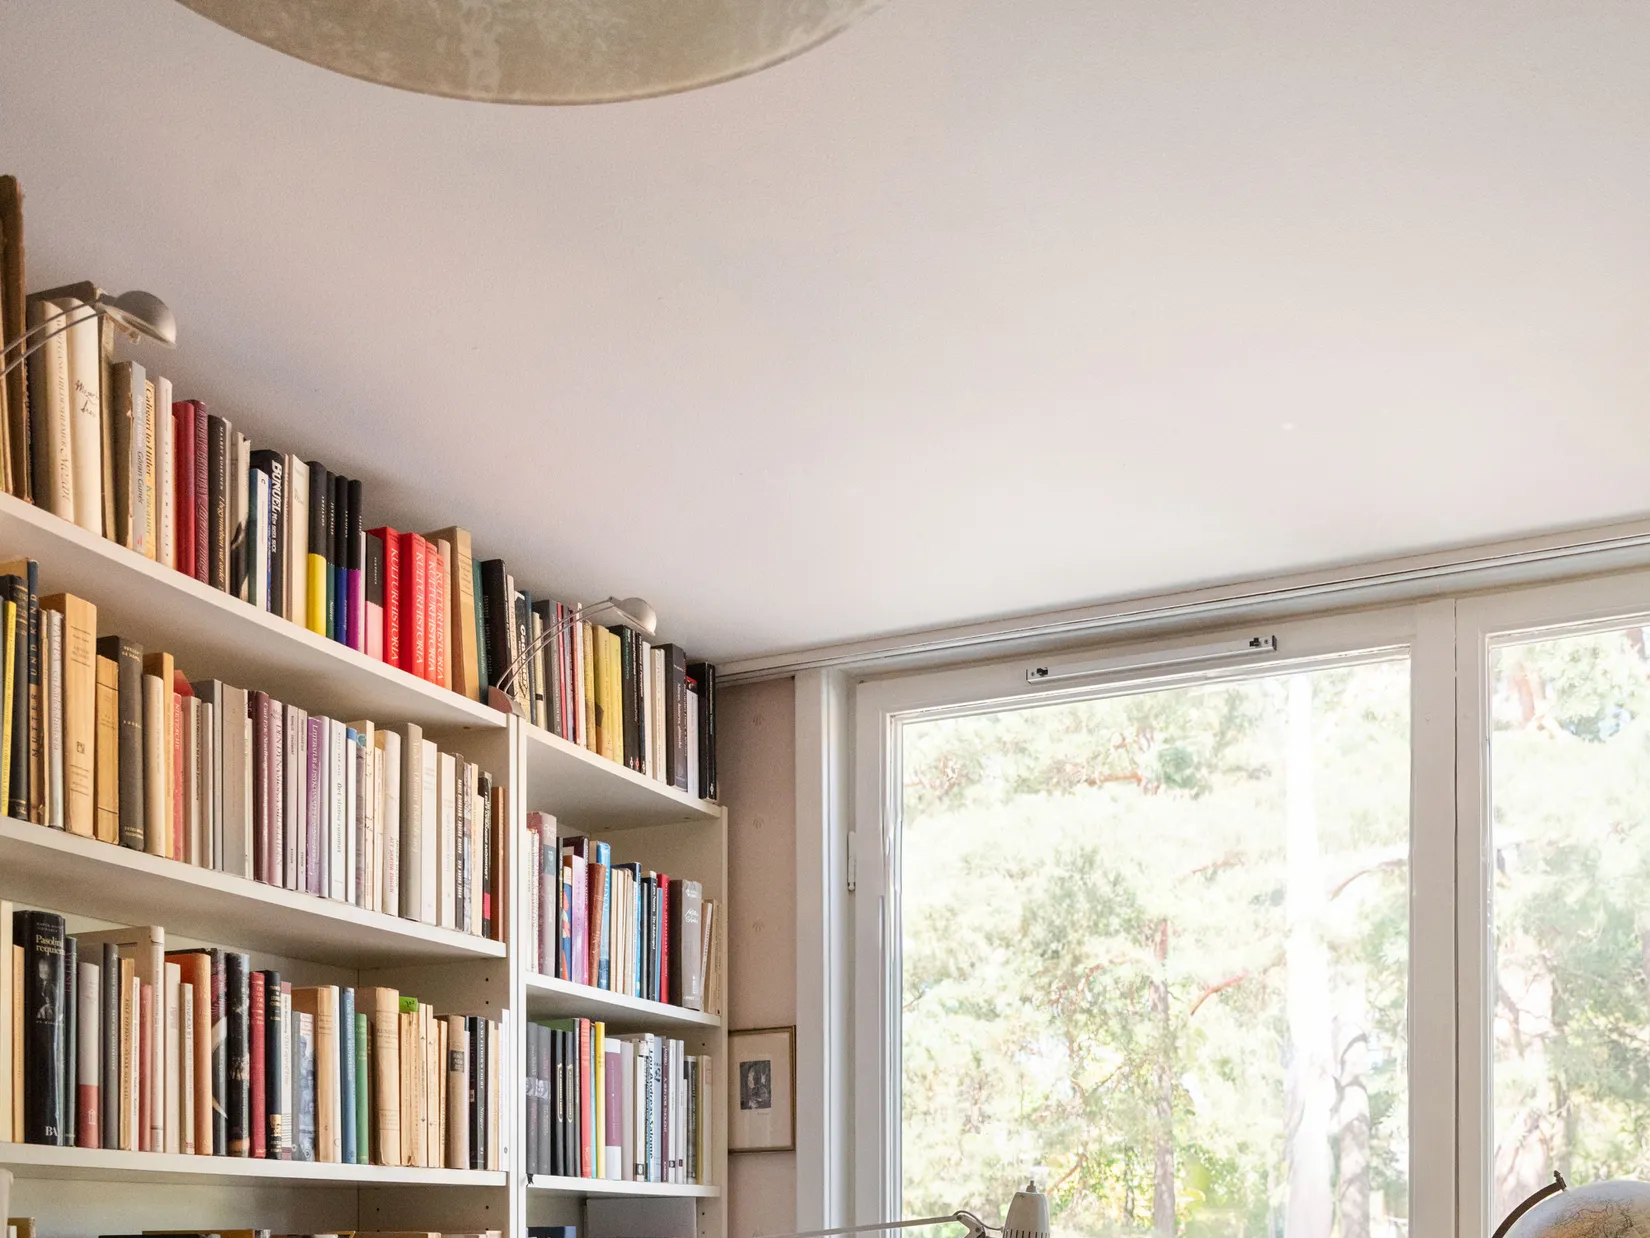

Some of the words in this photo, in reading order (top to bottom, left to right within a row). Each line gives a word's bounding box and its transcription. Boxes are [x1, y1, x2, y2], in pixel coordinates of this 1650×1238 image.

[217, 501, 225, 546] begynnelsen
[390, 547, 399, 661] KULTURHISTORIA
[416, 552, 424, 664] KULTURHISTORIA
[428, 561, 436, 672] KULTURHISTORIA
[436, 571, 444, 680] KULTURHISTORIA
[31, 694, 39, 757] MUTTER
[36, 935, 64, 947] Pasolini
